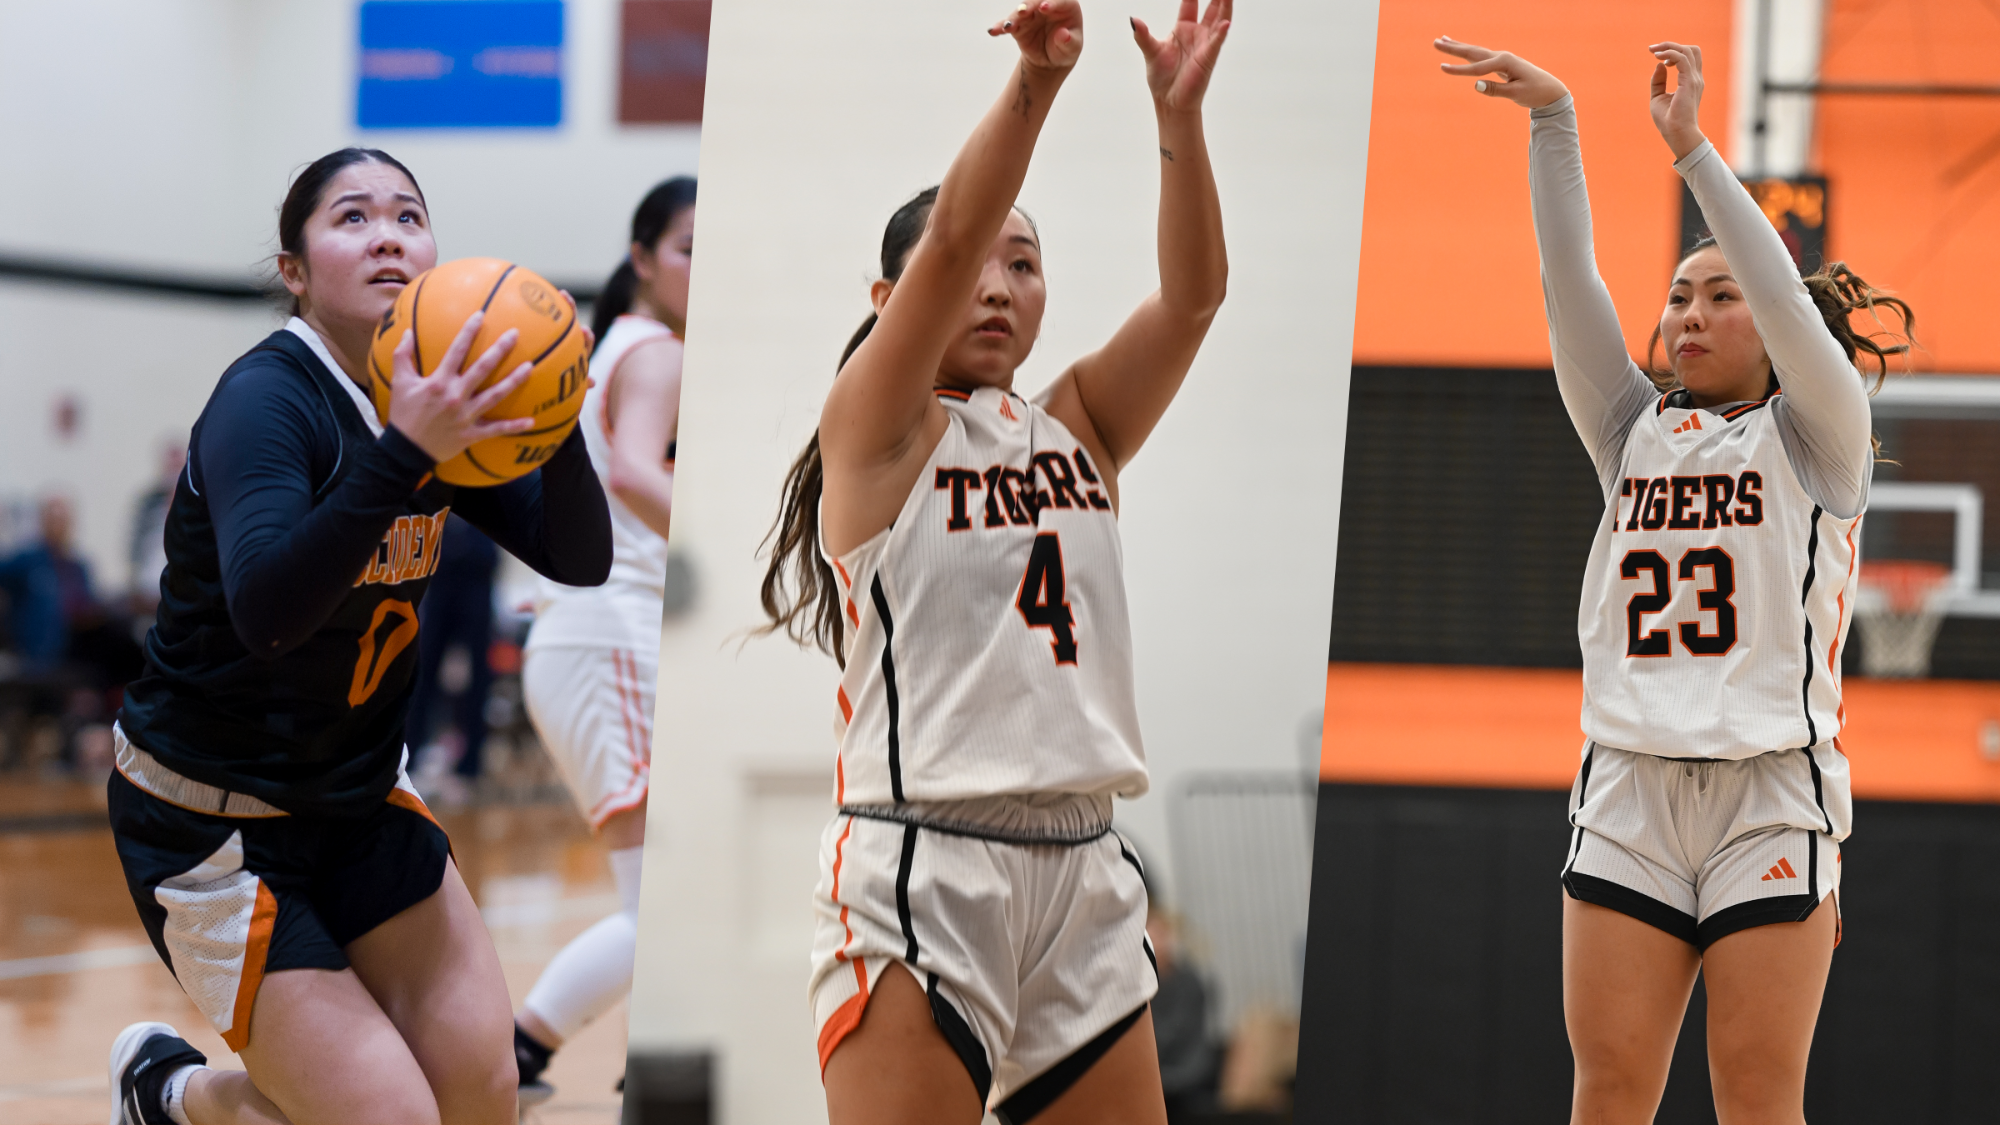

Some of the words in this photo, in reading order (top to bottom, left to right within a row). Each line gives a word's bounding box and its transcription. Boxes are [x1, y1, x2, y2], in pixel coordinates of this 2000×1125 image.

[347, 598, 420, 709] 0
[1015, 530, 1079, 668] 4
[1619, 545, 1739, 660] 23
